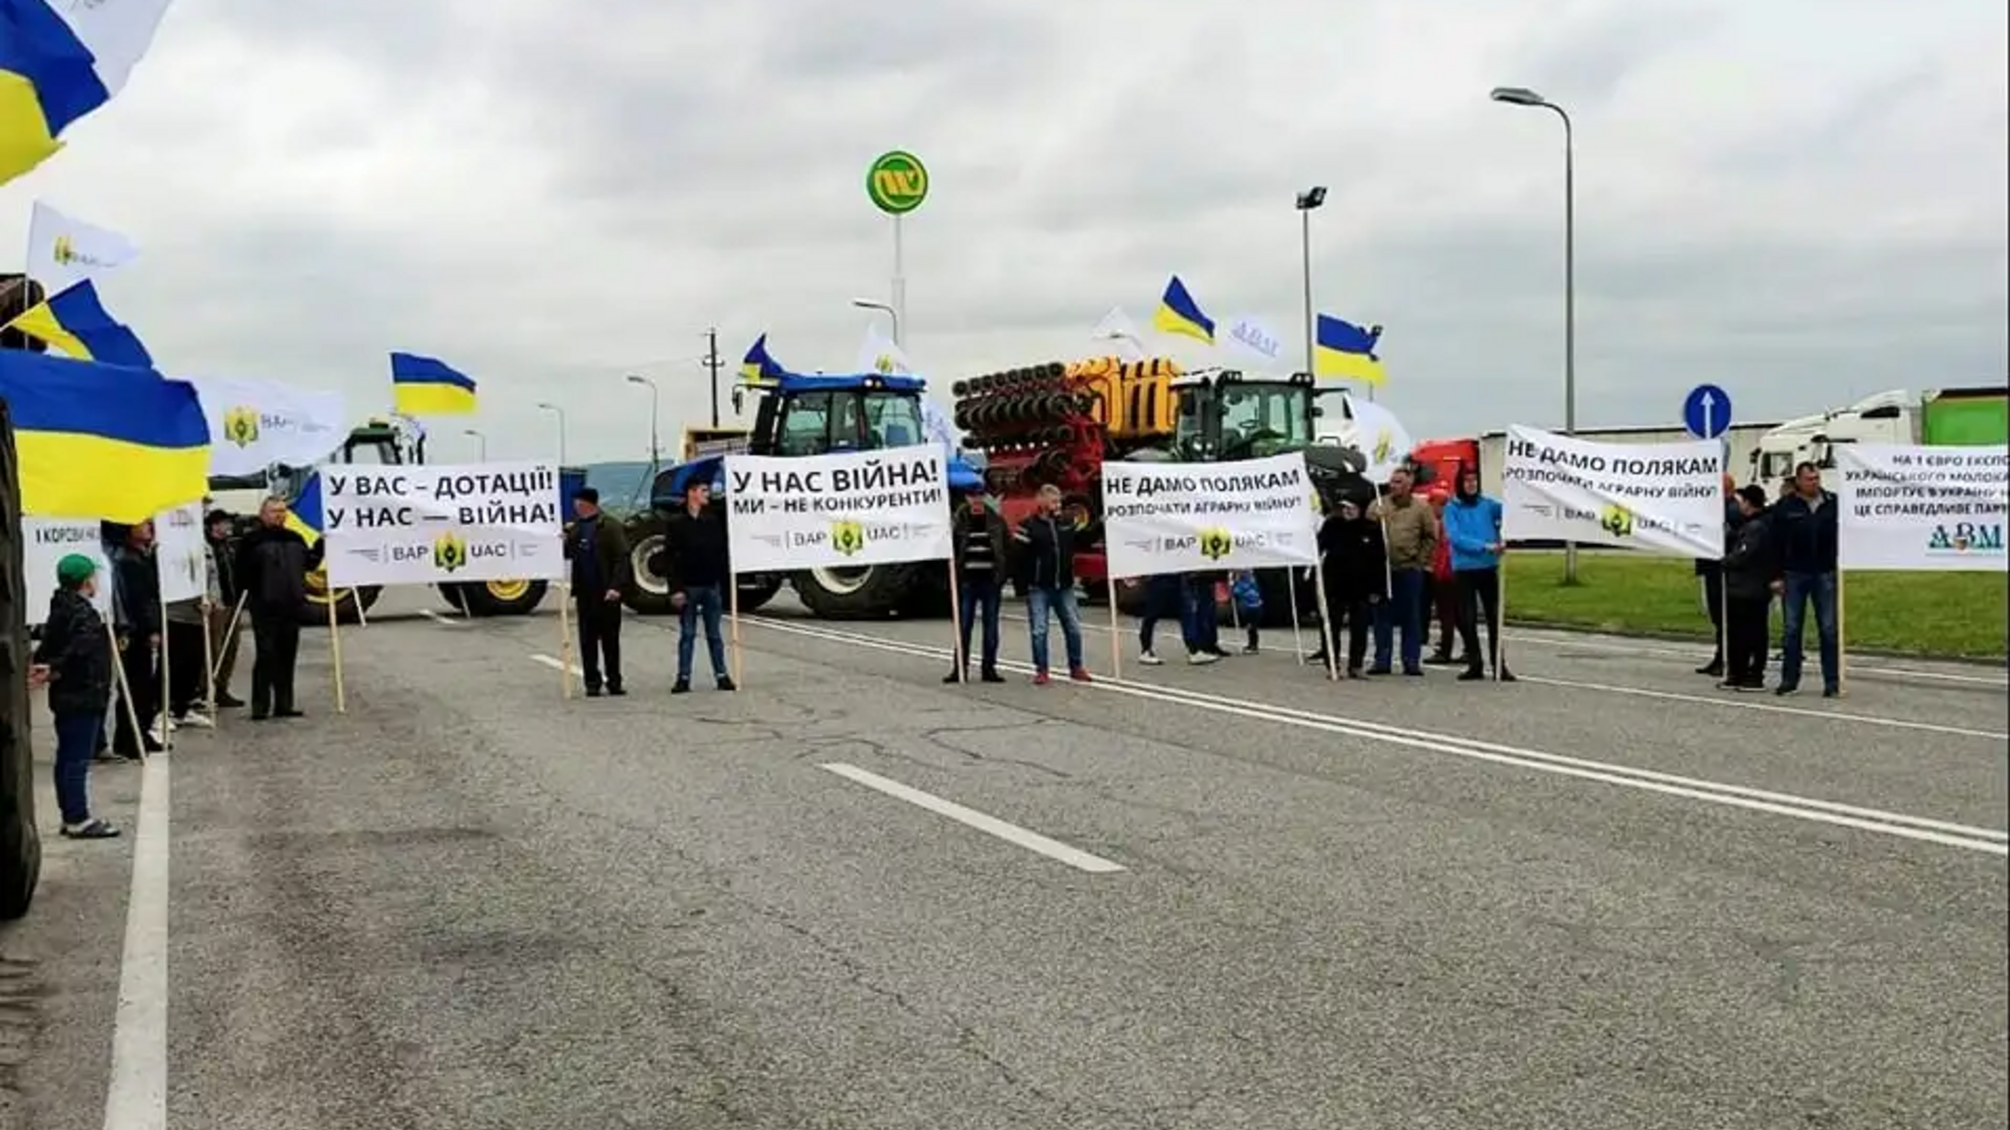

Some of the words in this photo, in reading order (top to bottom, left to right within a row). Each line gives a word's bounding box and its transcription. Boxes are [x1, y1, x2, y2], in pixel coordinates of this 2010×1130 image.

[1508, 440, 1537, 458] НЕ
[1540, 447, 1606, 472] ДАМО
[1612, 457, 1718, 476] ПОЛЯКАМ
[330, 475, 347, 496] У
[356, 475, 407, 496] ВАС
[435, 465, 554, 500] ДОТАЦІЇ!
[733, 471, 752, 494] У
[762, 471, 823, 493] НАС
[832, 459, 939, 492] ВІЙНА!
[1107, 477, 1132, 494] НЕ
[1137, 477, 1197, 496] ДАМО
[1201, 469, 1300, 493] ПОЛЯКАМ
[328, 508, 345, 529] У
[356, 507, 413, 528] НАС
[459, 500, 556, 525] ВІЙНА!
[734, 499, 764, 515] МИ
[785, 497, 807, 512] НЕ
[813, 488, 942, 512] КОНКУРЕНТИ!
